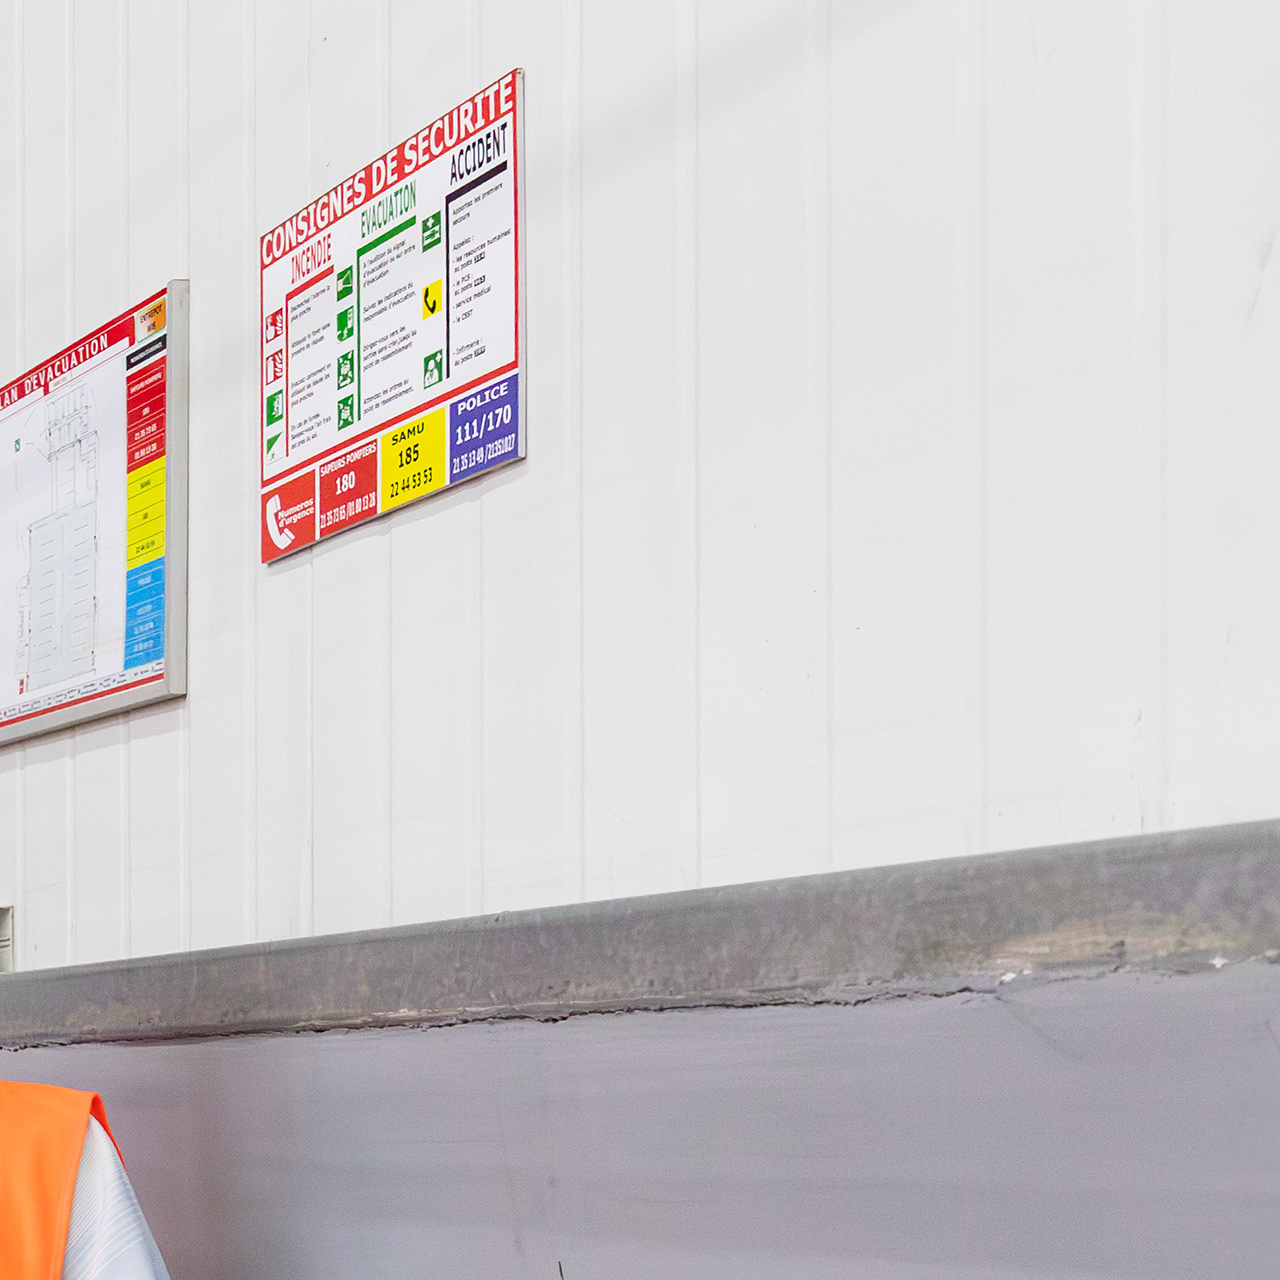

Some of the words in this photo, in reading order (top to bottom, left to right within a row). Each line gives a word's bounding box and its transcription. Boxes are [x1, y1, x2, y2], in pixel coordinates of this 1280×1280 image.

[262, 170, 366, 264] CONSIGNES
[372, 149, 398, 194] DE
[404, 74, 513, 173] SECURITE
[450, 122, 507, 185] ACCIDENT
[361, 180, 416, 238] EVACUATION
[292, 233, 331, 284] INCENDIE
[24, 330, 108, 397] D'EVACUATION
[458, 382, 508, 415] POLICE
[392, 422, 424, 446] SAMU
[456, 404, 511, 445] 111/170
[321, 457, 346, 477] SAPEURS
[346, 442, 376, 464] POMPIERS
[399, 443, 419, 468] 185
[336, 471, 355, 494] 180
[390, 482, 399, 498] 22
[401, 477, 410, 493] 44
[412, 472, 421, 489] 53
[424, 467, 432, 484] 53
[278, 498, 313, 520] Numeros
[278, 507, 314, 527] d'urgence
